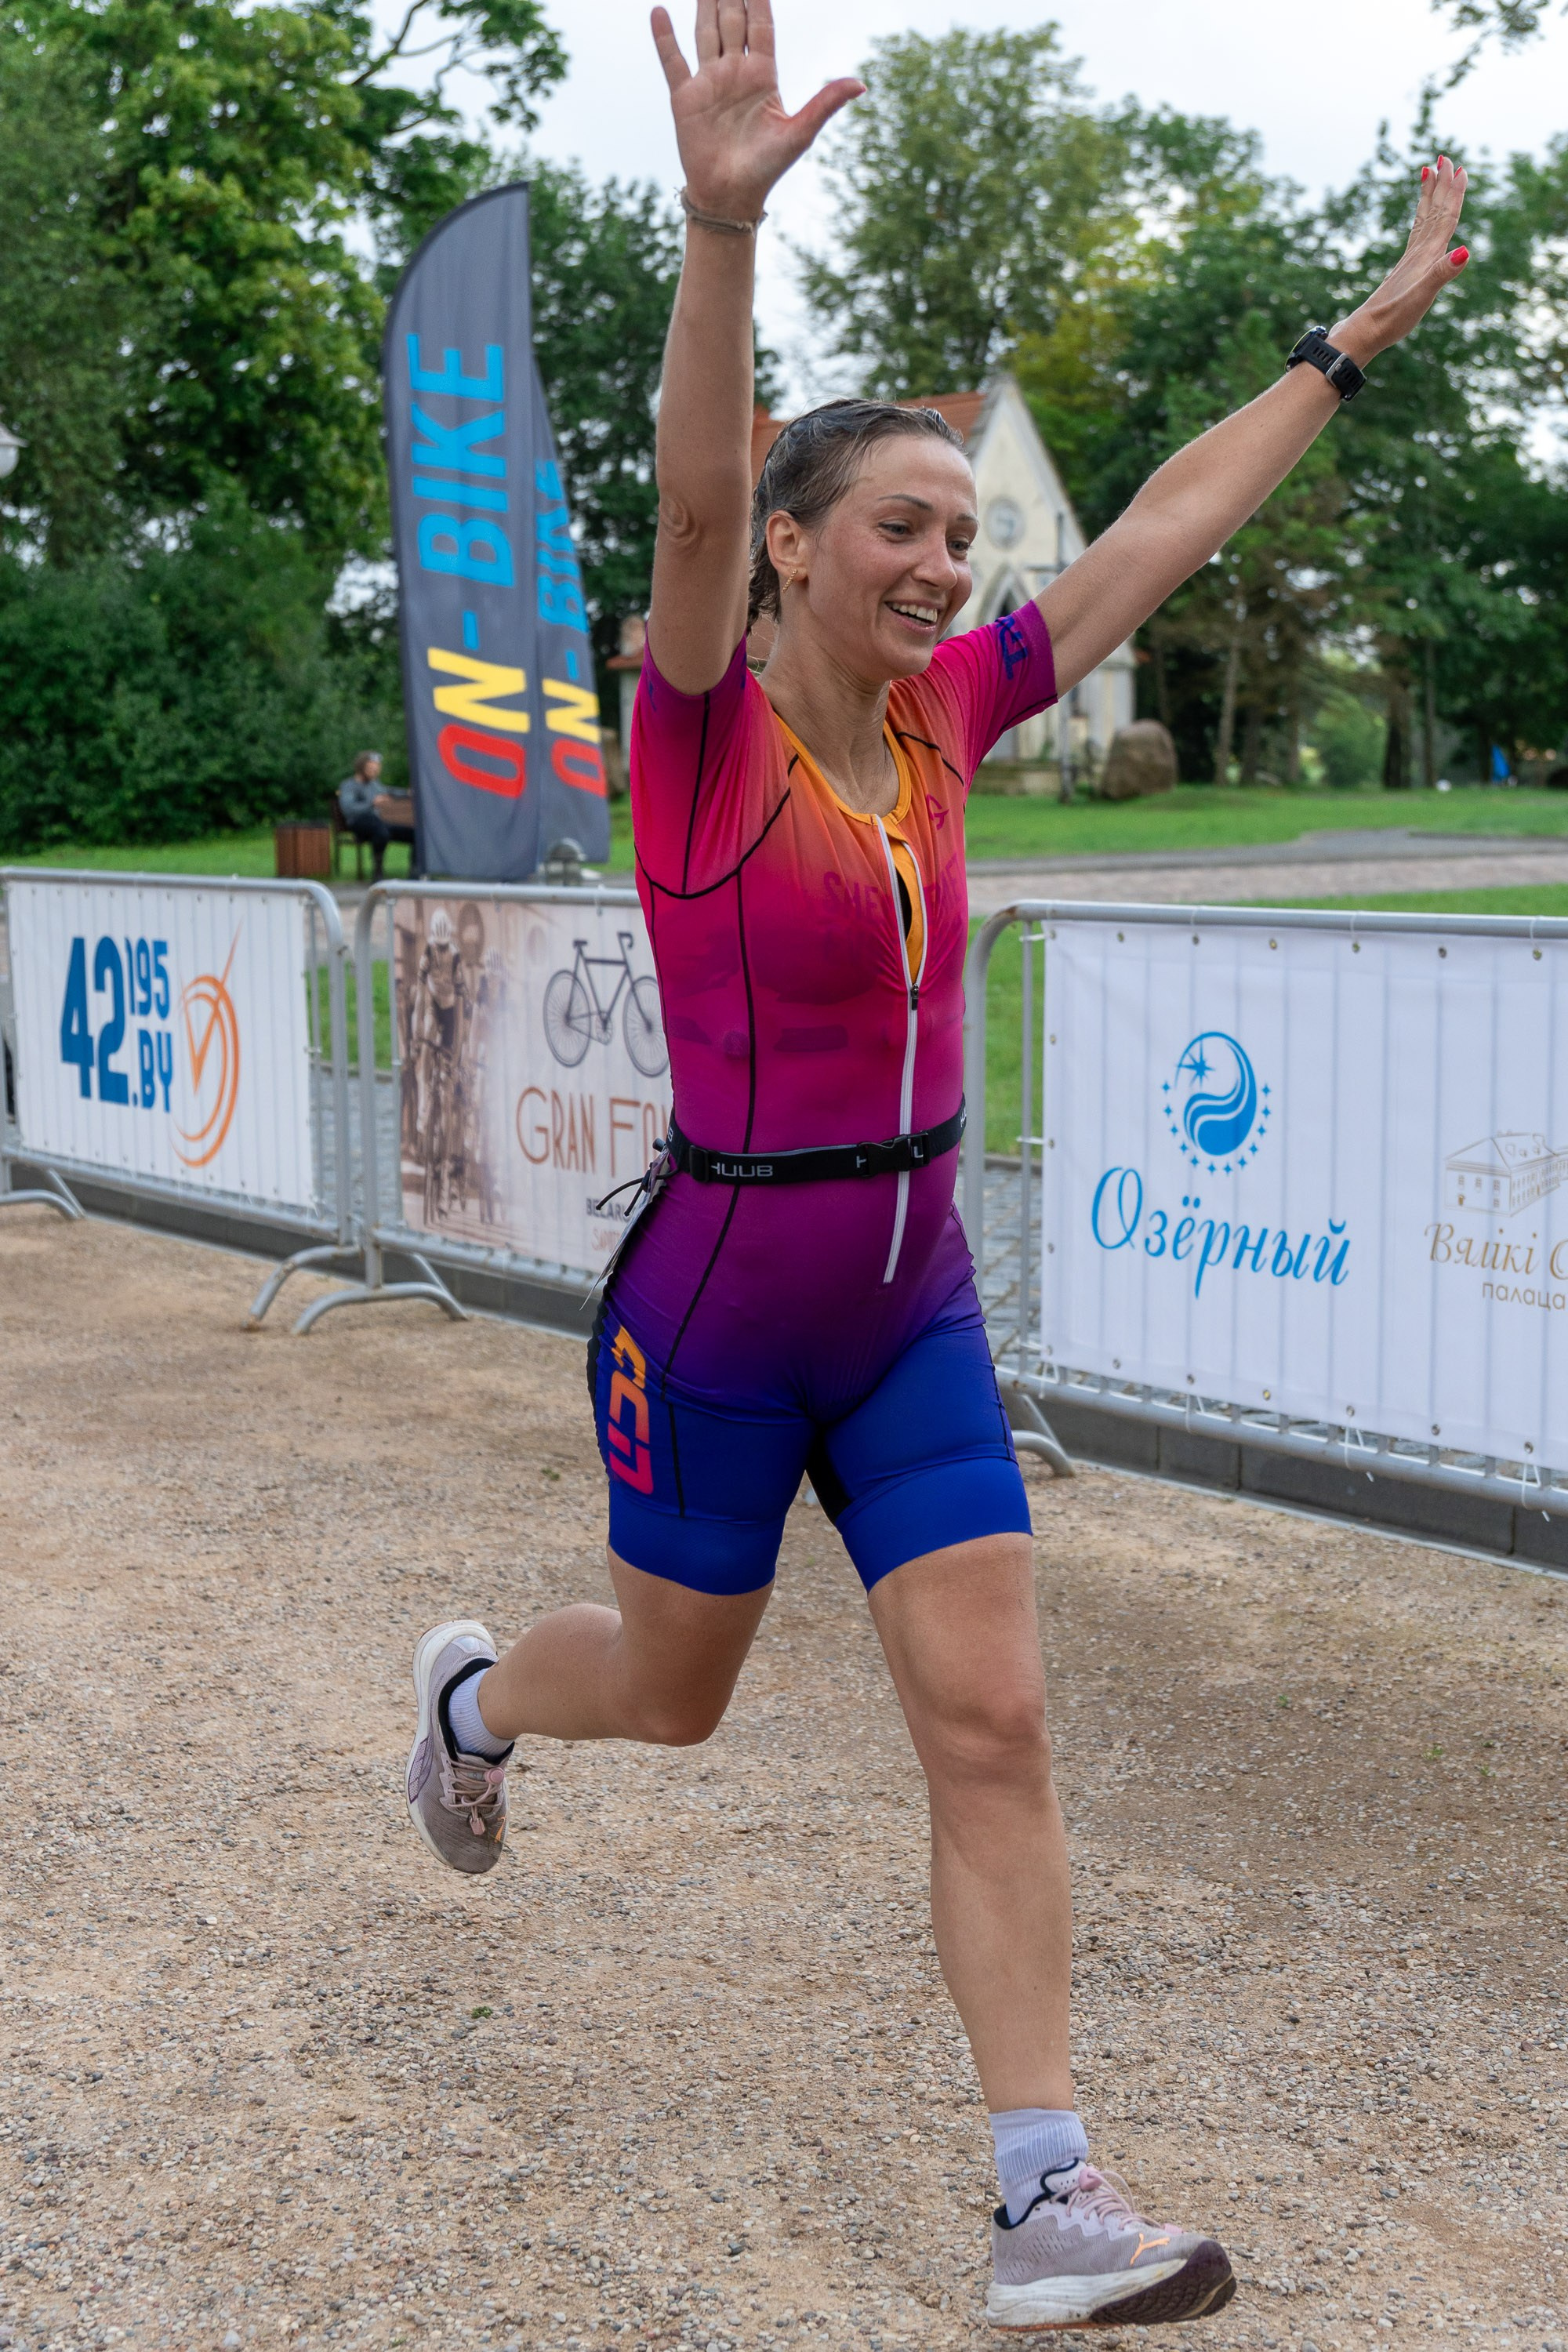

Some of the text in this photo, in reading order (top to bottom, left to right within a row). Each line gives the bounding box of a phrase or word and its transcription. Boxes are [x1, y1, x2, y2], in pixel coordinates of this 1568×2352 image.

[516, 1086, 596, 1174] GRAN
[1091, 1167, 1352, 1300] Озёрный
[1424, 1223, 1541, 1276] Вялікі
[1482, 1280, 1566, 1312] палаца
